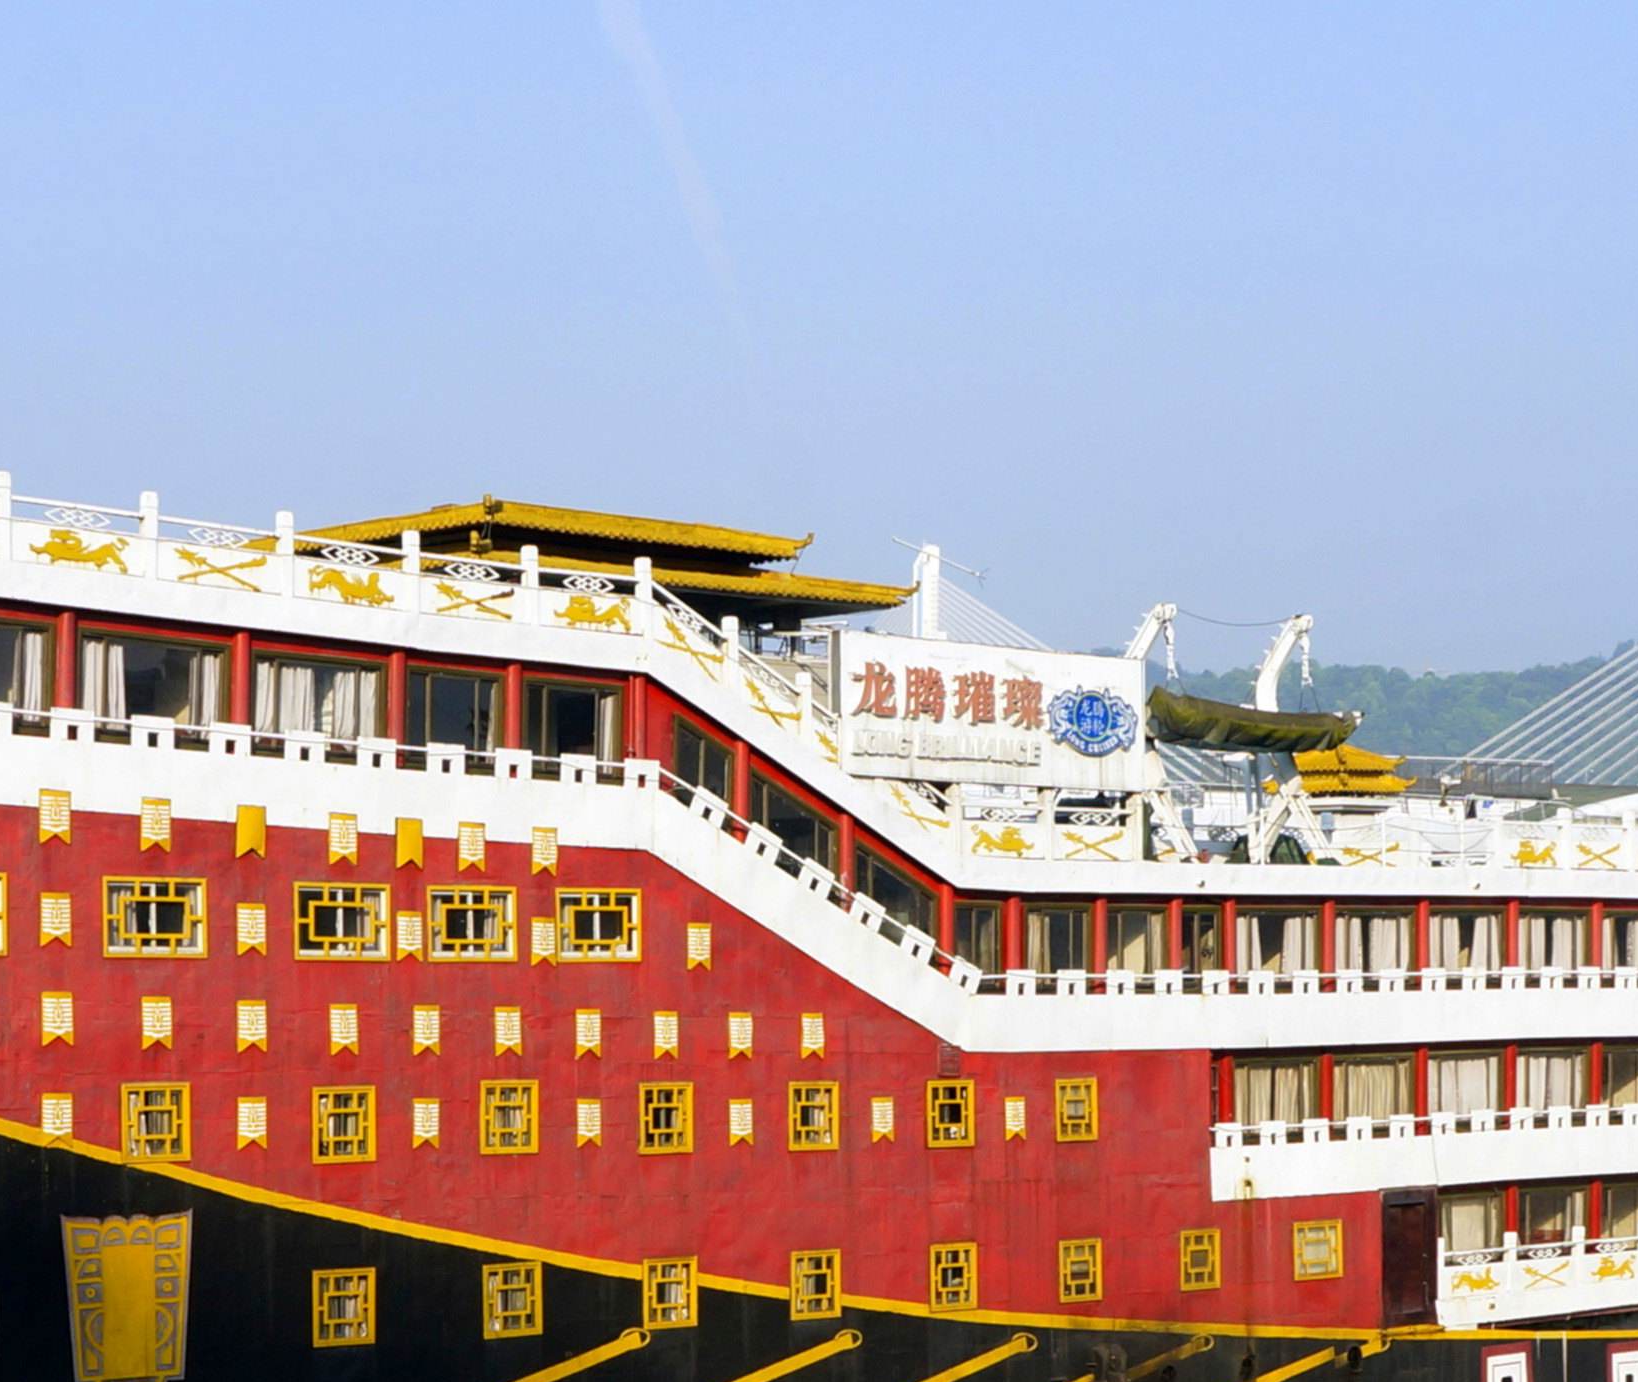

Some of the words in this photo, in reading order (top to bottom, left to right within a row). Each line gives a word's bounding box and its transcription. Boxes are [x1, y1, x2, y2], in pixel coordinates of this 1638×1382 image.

[851, 661, 1045, 730] 龙腾璀璨
[852, 729, 913, 759] LONG
[917, 733, 1042, 767] BRILLIANCE
